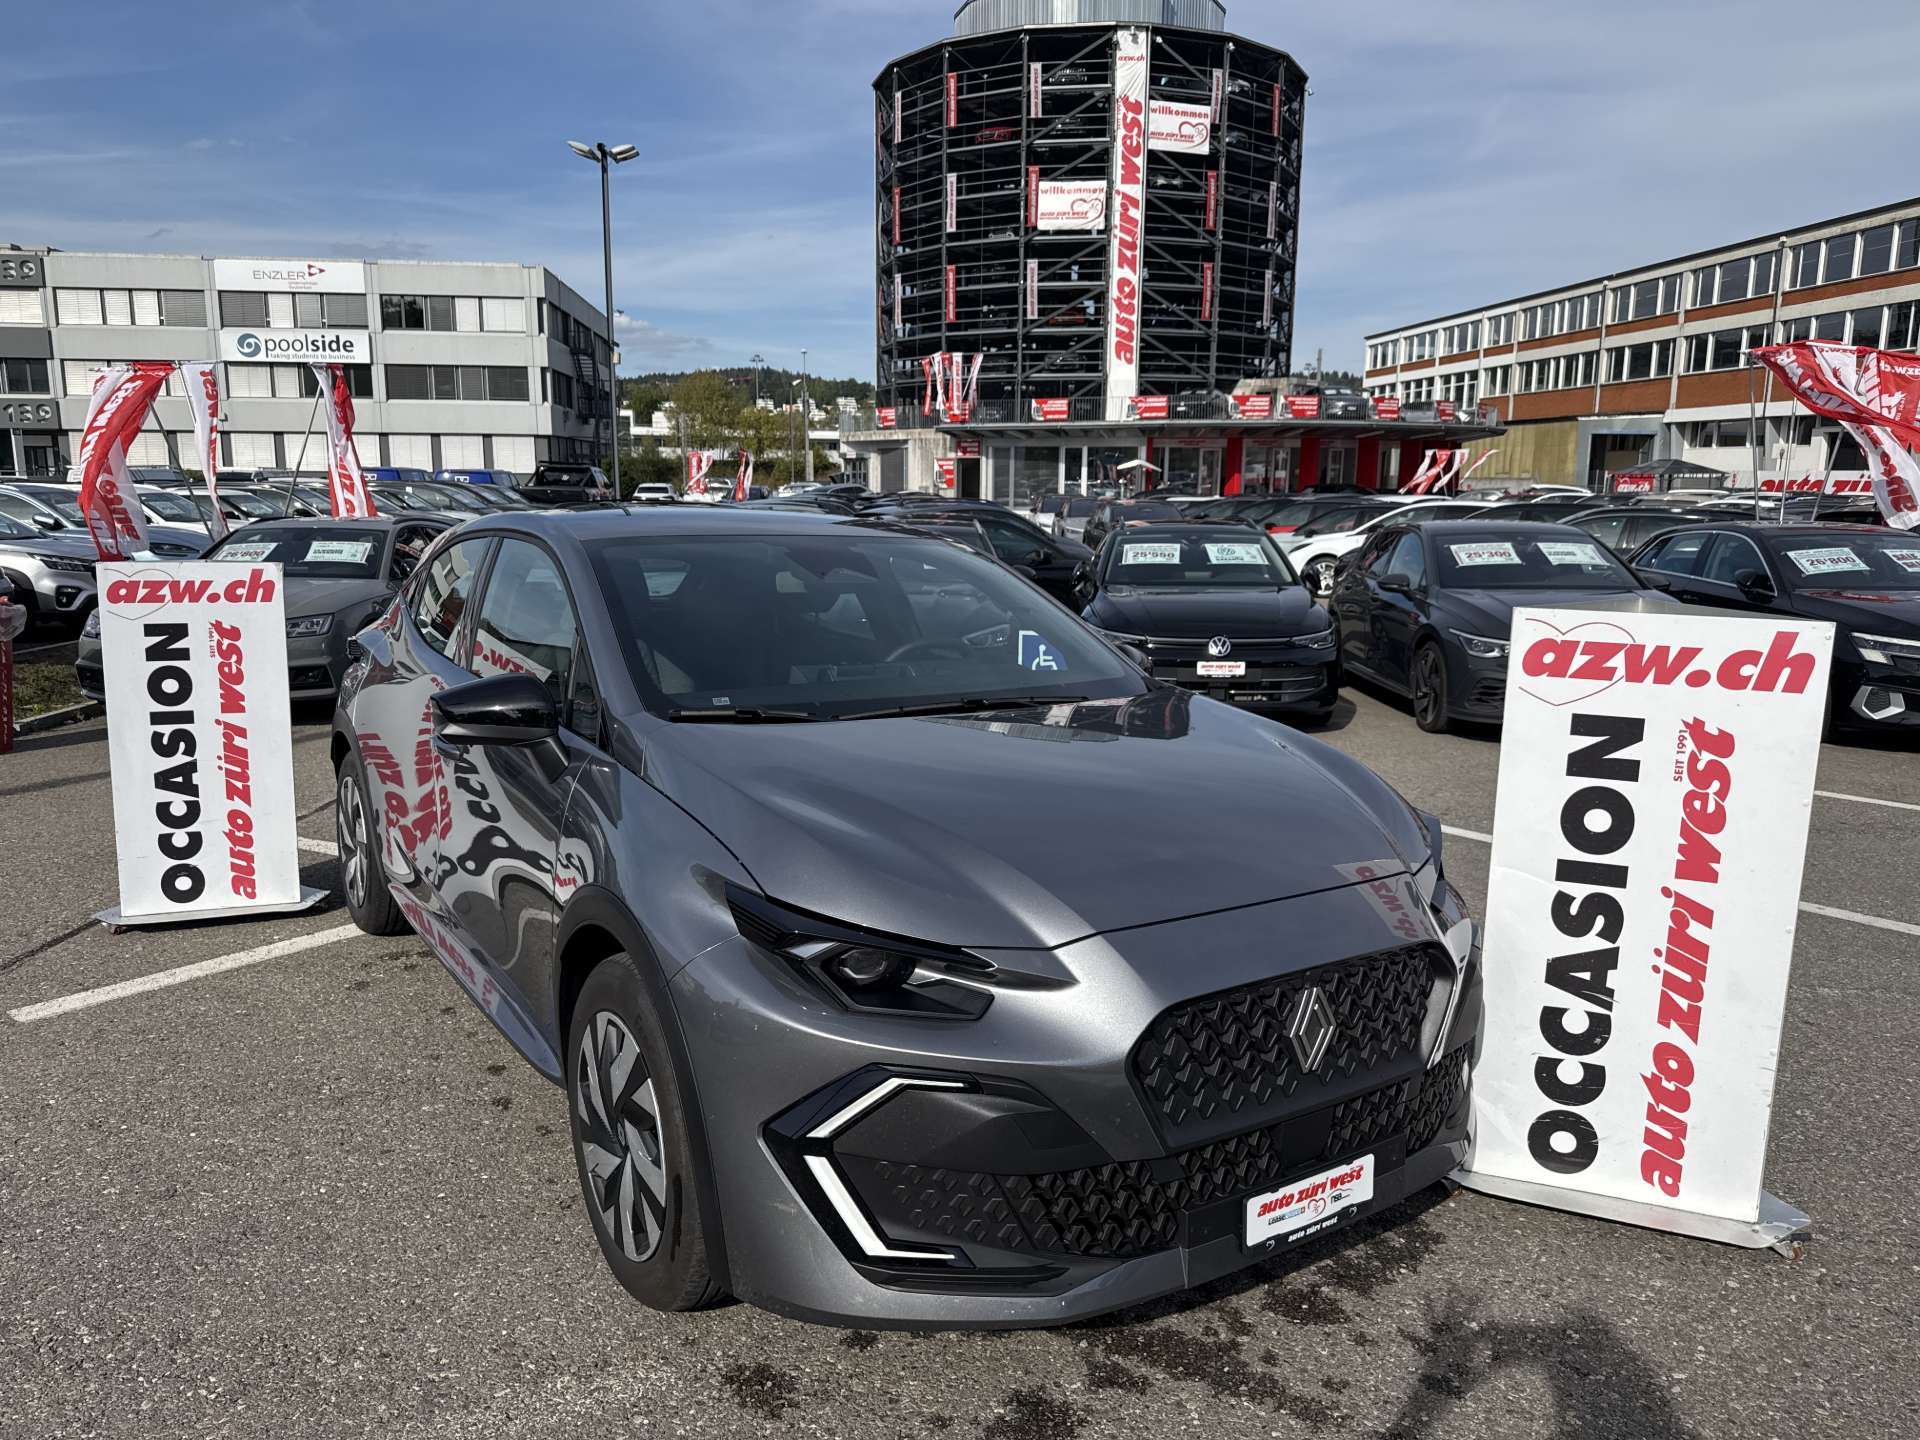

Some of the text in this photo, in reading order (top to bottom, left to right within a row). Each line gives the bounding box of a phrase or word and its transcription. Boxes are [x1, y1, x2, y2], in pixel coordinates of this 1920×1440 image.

[1118, 54, 1145, 62] azw.ch
[1150, 106, 1209, 120] willkommen
[1040, 186, 1104, 195] willkommen
[1112, 95, 1143, 364] auto züri west
[253, 270, 305, 280] ENZLER
[264, 334, 354, 358] poolside
[3, 403, 52, 424] 139
[1880, 451, 1917, 512] auto
[98, 479, 141, 540] auto
[1464, 551, 1512, 560] 25'300
[1806, 556, 1856, 566] 26'800
[106, 568, 275, 605] azw.ch
[1522, 630, 1816, 694] azw.ch
[143, 623, 206, 904] OCCASION
[211, 618, 257, 900] auto züri west
[1673, 730, 1688, 782] SEIT 1991
[1527, 712, 1646, 1174] OCCASION
[1639, 716, 1736, 1199] auto züri west
[1257, 1192, 1295, 1217] auto
[1295, 1177, 1329, 1204] züri
[1330, 1164, 1364, 1190] west
[1288, 1216, 1338, 1242] auto züri west
